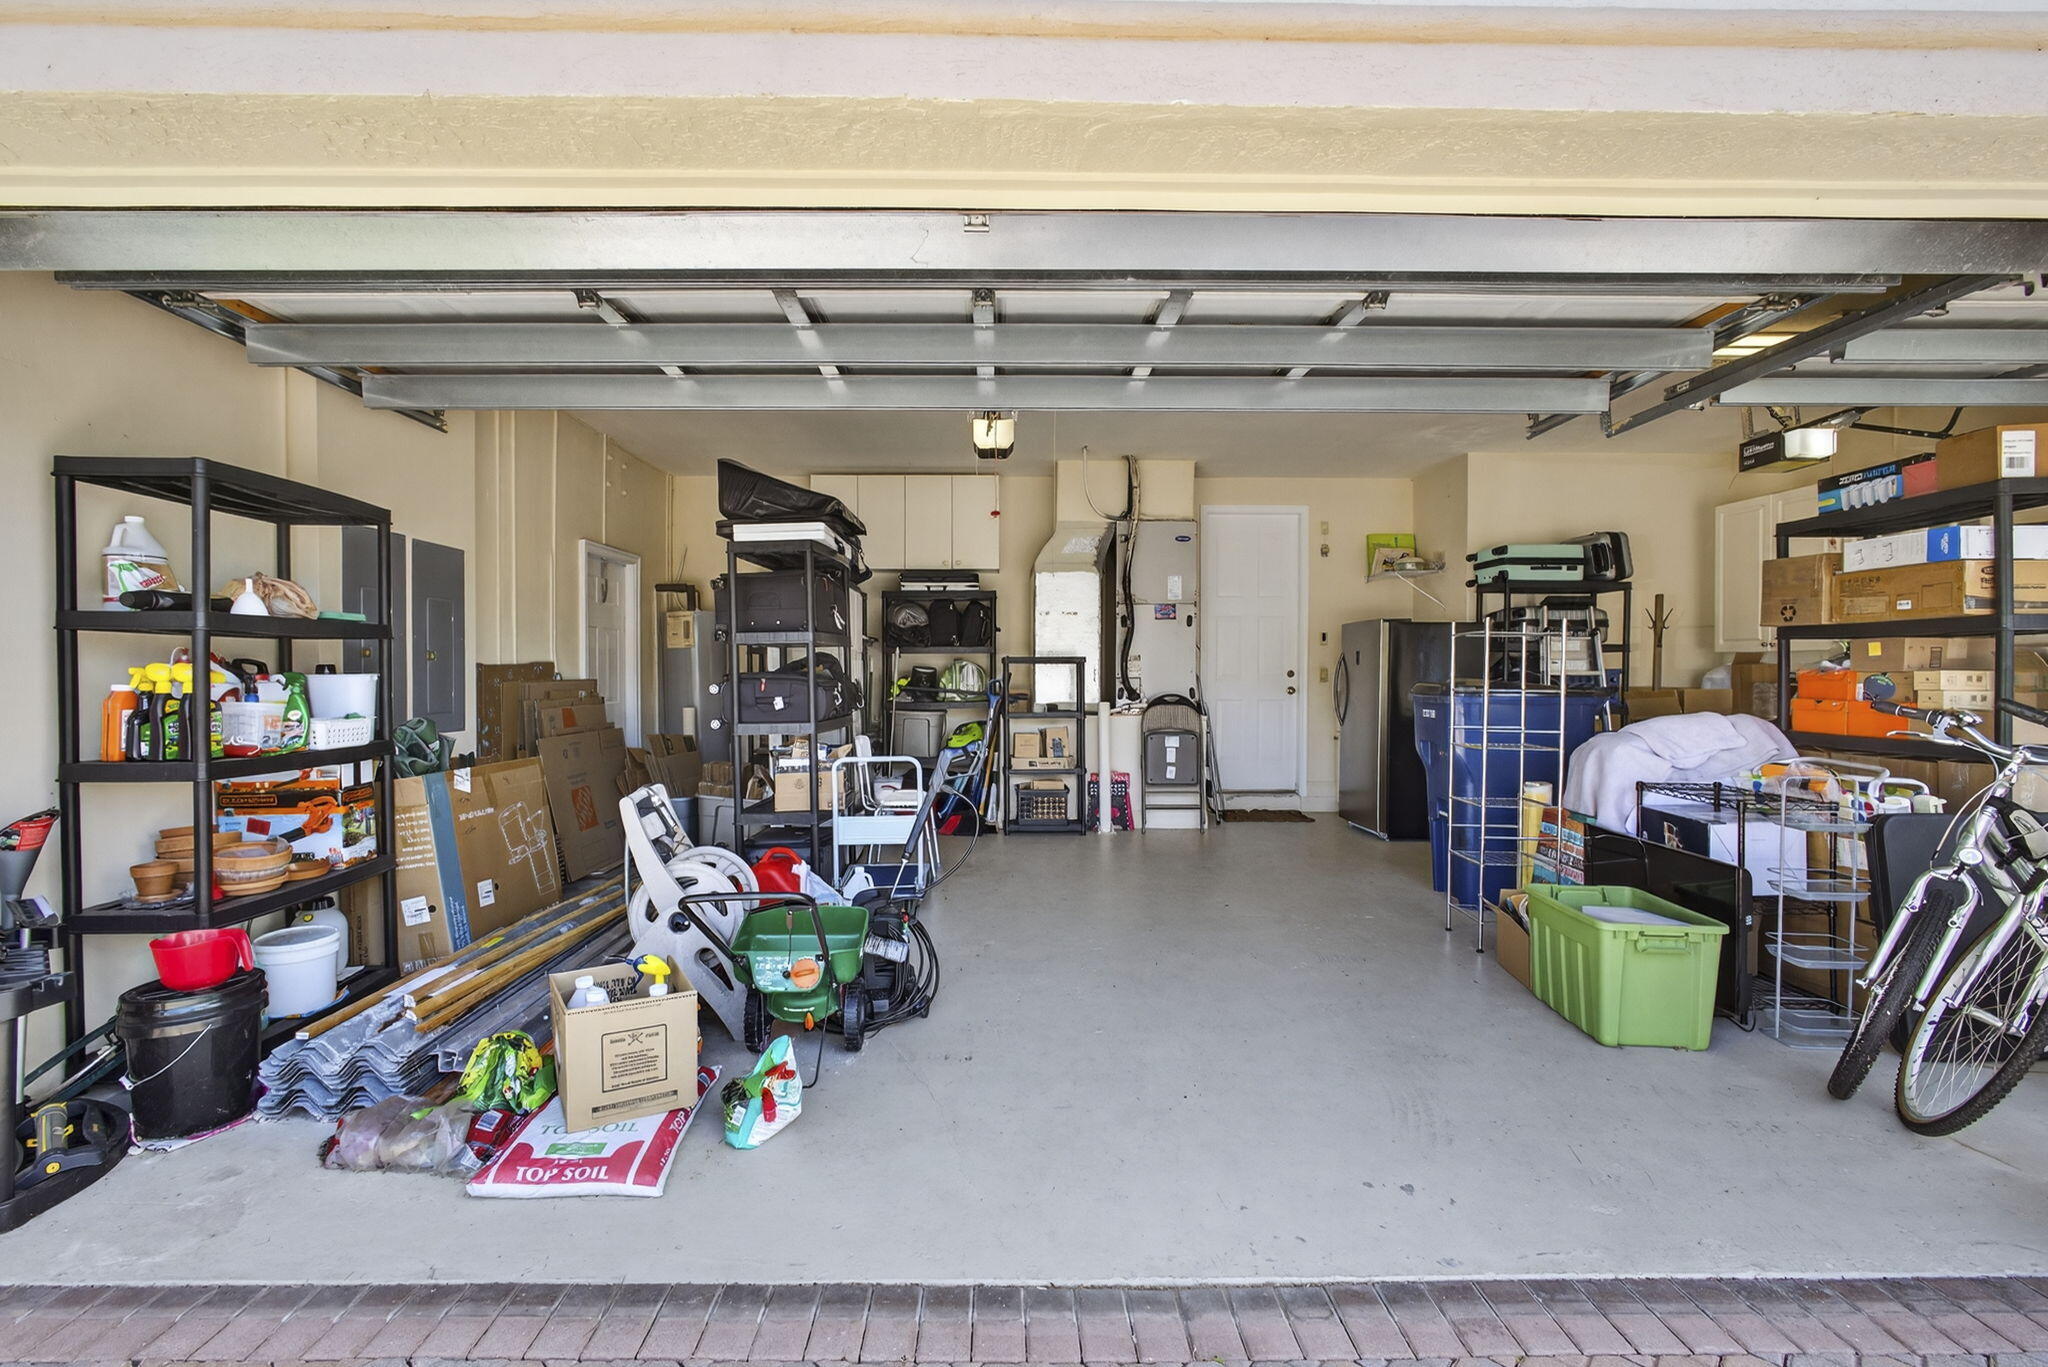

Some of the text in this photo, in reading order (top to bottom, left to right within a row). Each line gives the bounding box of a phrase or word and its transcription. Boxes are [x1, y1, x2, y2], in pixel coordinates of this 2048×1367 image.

[669, 1110, 686, 1134] TOP
[515, 1164, 609, 1182] TOP SOIL
